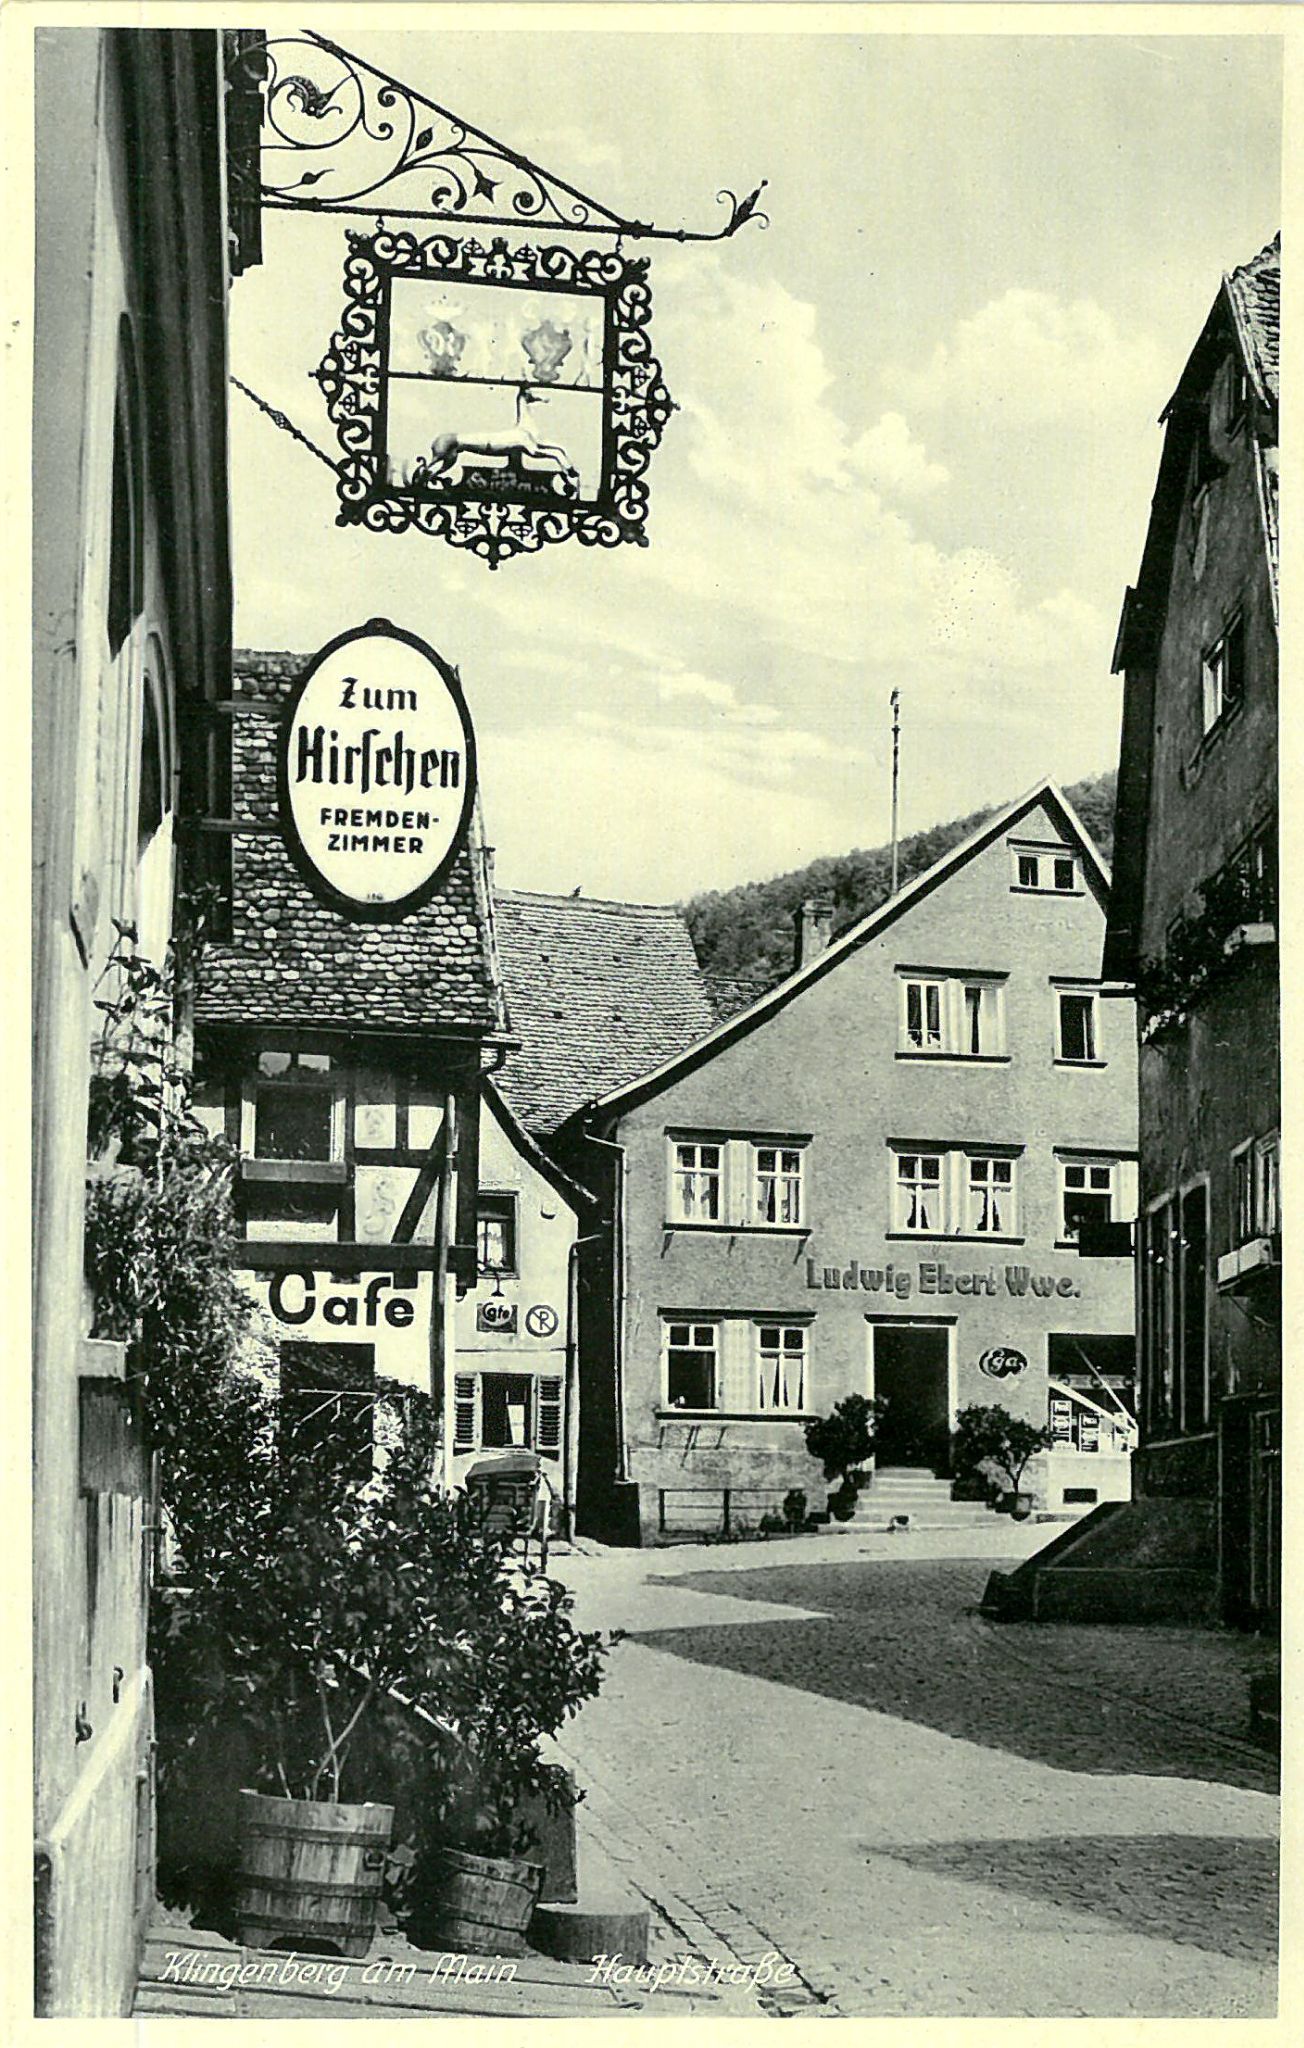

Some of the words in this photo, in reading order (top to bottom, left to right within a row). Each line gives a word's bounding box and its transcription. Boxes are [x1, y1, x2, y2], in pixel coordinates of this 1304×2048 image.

[339, 677, 418, 711] Zum
[320, 808, 440, 830] FREMDEN-
[327, 834, 424, 854] ZIMMER
[806, 1258, 911, 1300] Ludwig
[918, 1262, 997, 1296] Ebert
[1004, 1265, 1081, 1299] Wwe.
[268, 1270, 415, 1328] Cafe
